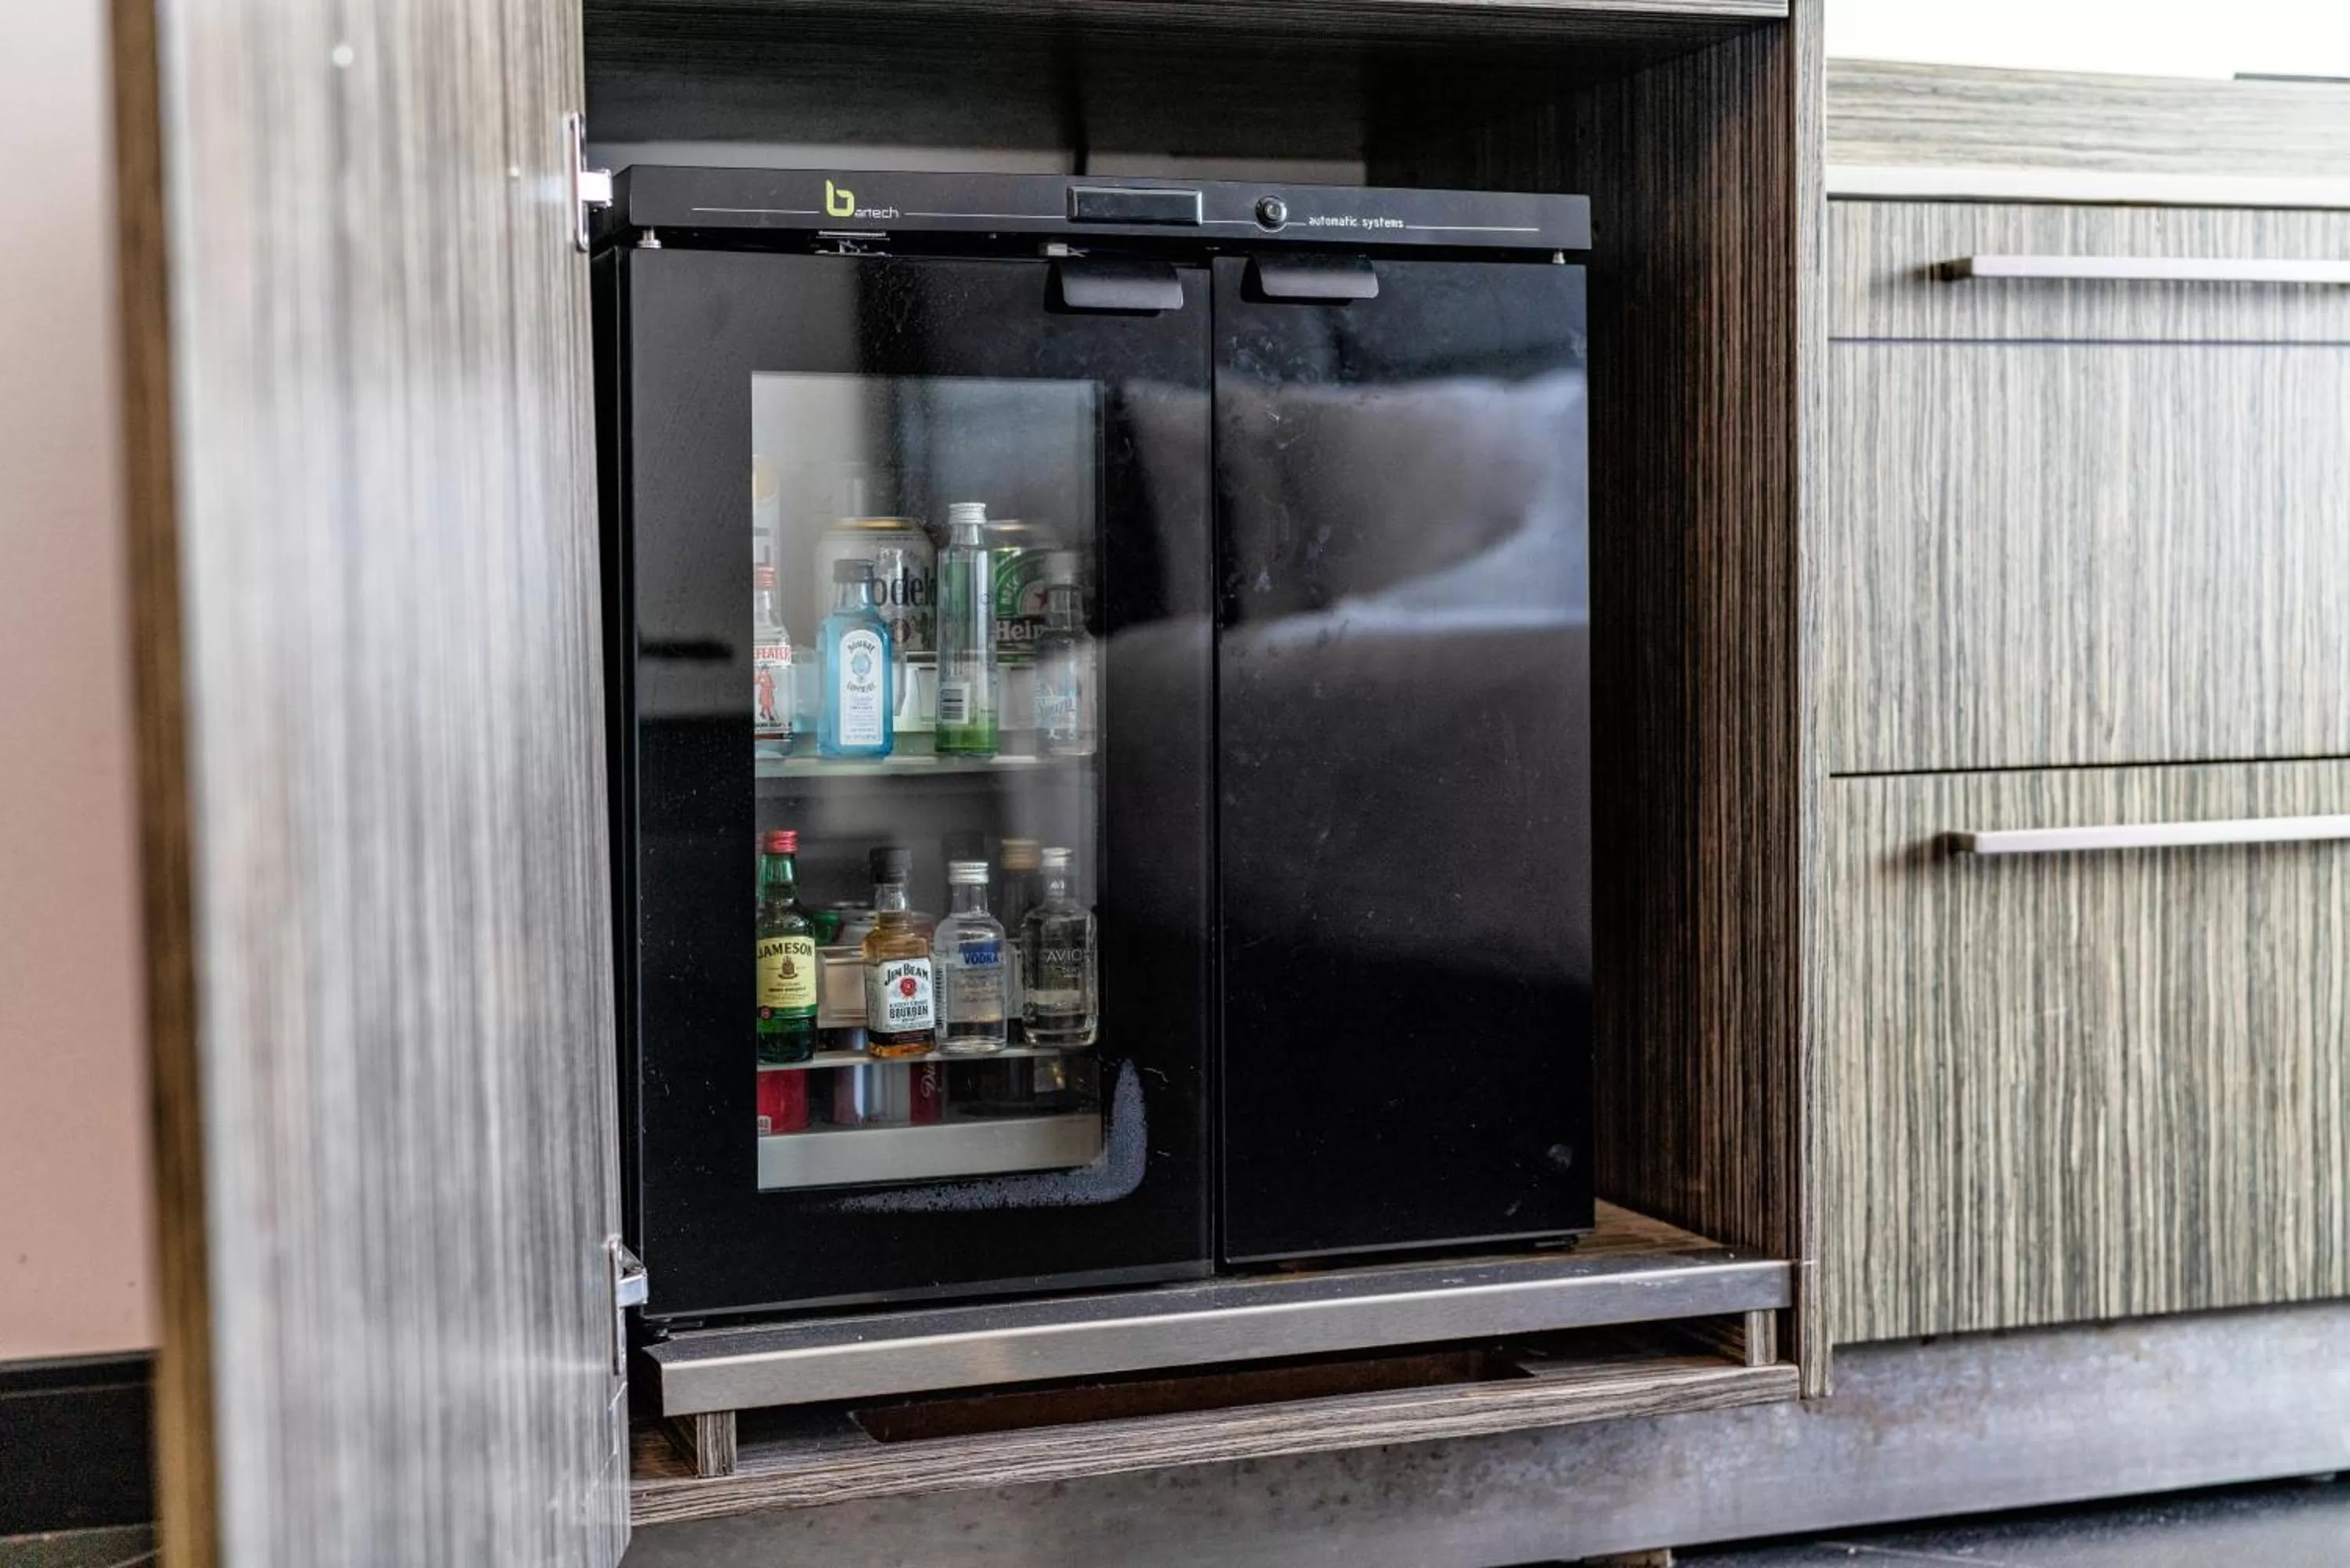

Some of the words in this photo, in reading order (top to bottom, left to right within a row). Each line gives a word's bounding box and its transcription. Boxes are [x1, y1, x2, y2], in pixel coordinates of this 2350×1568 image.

[826, 179, 899, 219] bartech
[1309, 215, 1358, 226] automatic
[1362, 217, 1405, 230] systems
[873, 565, 938, 607] odel
[757, 941, 814, 959] JAMESON
[963, 952, 999, 965] VODKA
[903, 963, 929, 980] BEAM
[889, 1005, 929, 1019] BOURBON
